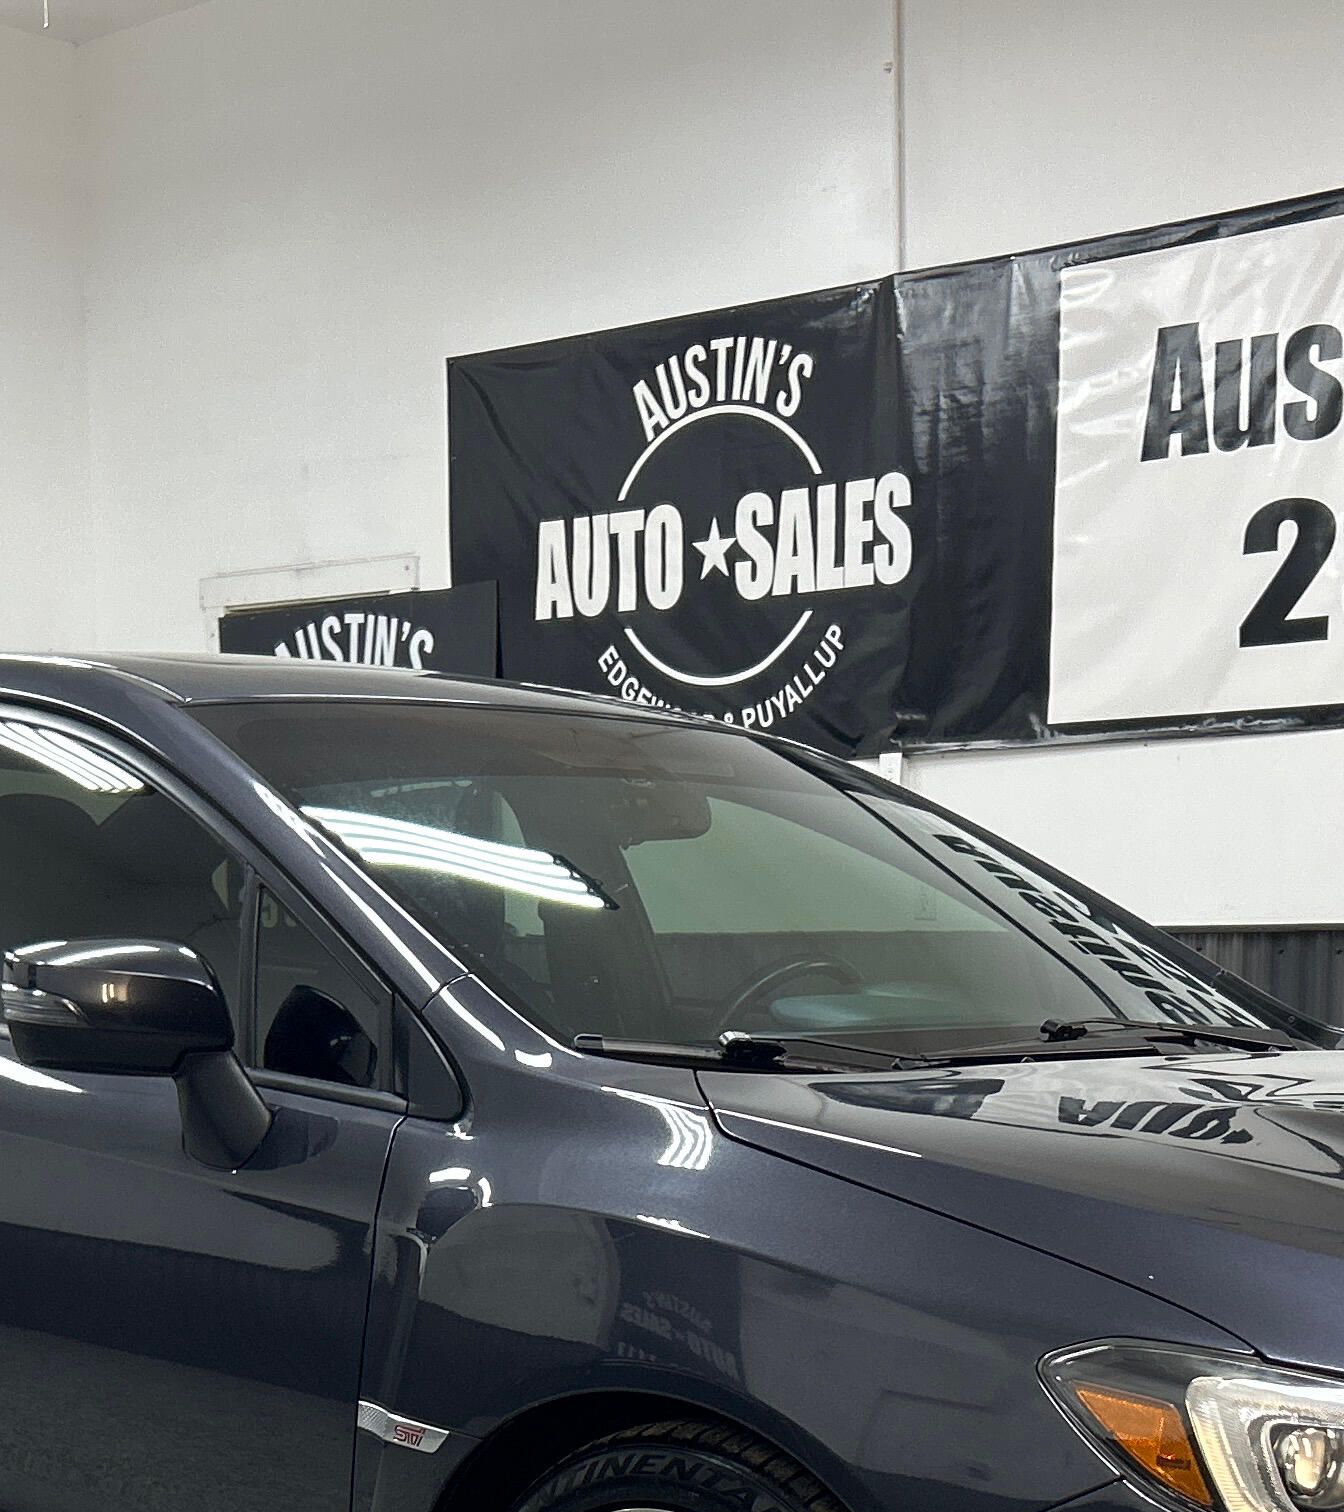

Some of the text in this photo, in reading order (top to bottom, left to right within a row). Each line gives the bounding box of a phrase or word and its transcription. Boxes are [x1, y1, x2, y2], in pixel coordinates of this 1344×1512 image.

[632, 336, 814, 442] AUSTIN'S
[535, 471, 912, 621] AUTO SALES
[274, 612, 435, 670] USTIN'S
[597, 645, 716, 720] EDGE
[741, 623, 846, 729] PUYALLUP
